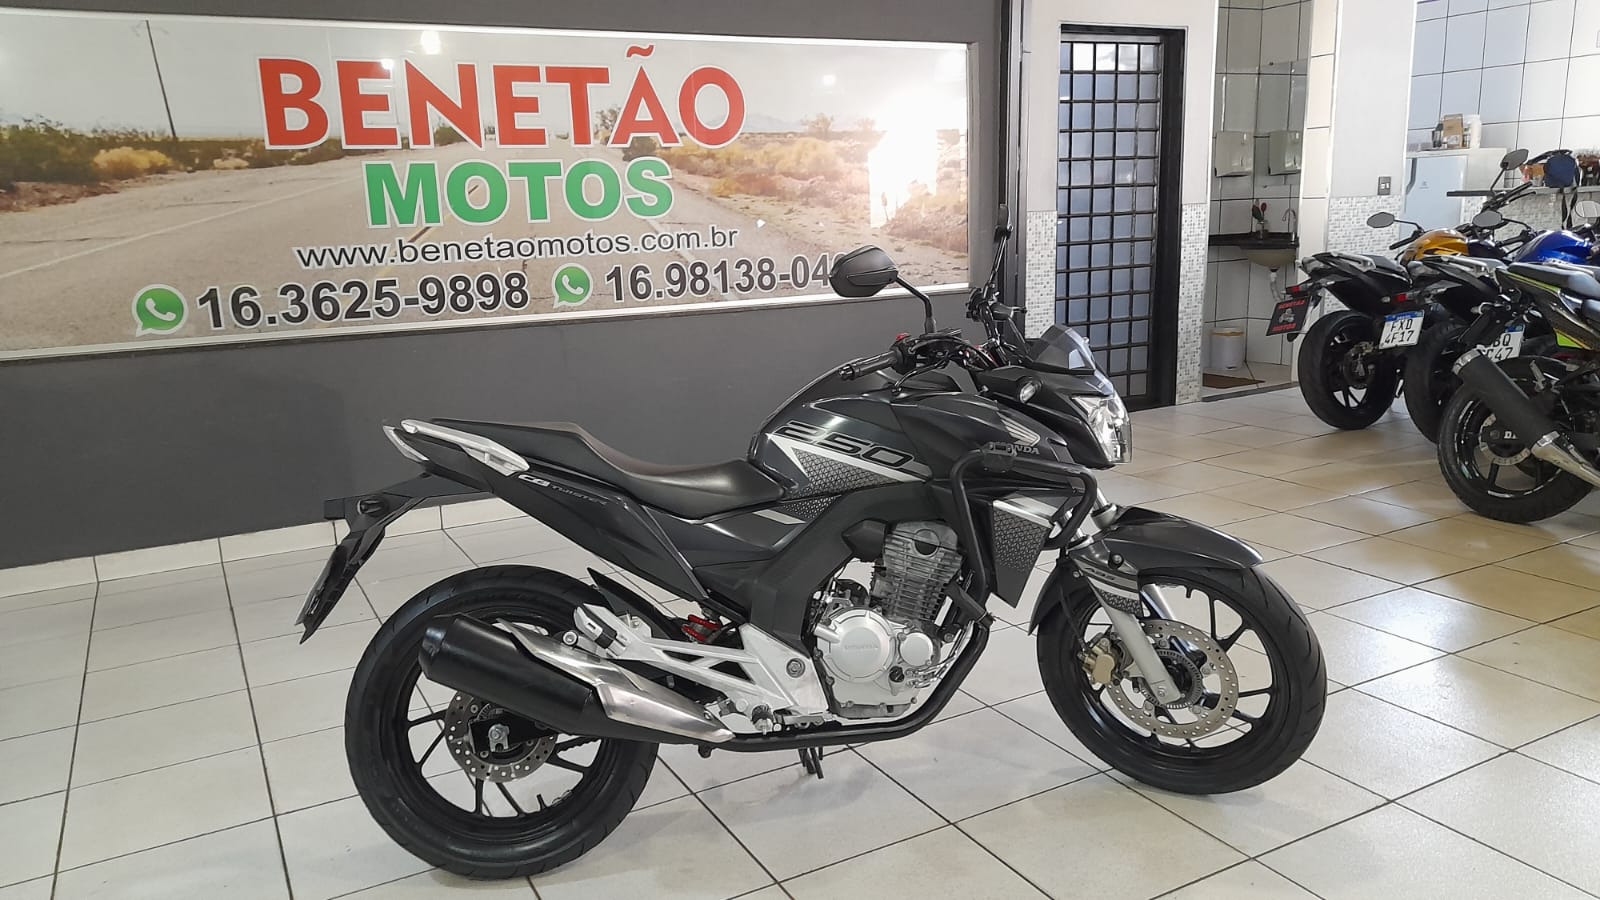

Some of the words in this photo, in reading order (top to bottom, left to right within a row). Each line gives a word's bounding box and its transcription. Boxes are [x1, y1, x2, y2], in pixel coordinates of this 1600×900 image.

[258, 45, 744, 149] BENETÃO
[365, 158, 673, 227] MOTOS
[295, 226, 738, 268] www.benetaomotos.com.br
[198, 272, 529, 328] 16.3625-9898
[605, 252, 847, 301] 16.98138-04
[1384, 330, 1415, 344] 4F17
[773, 419, 914, 469] 250
